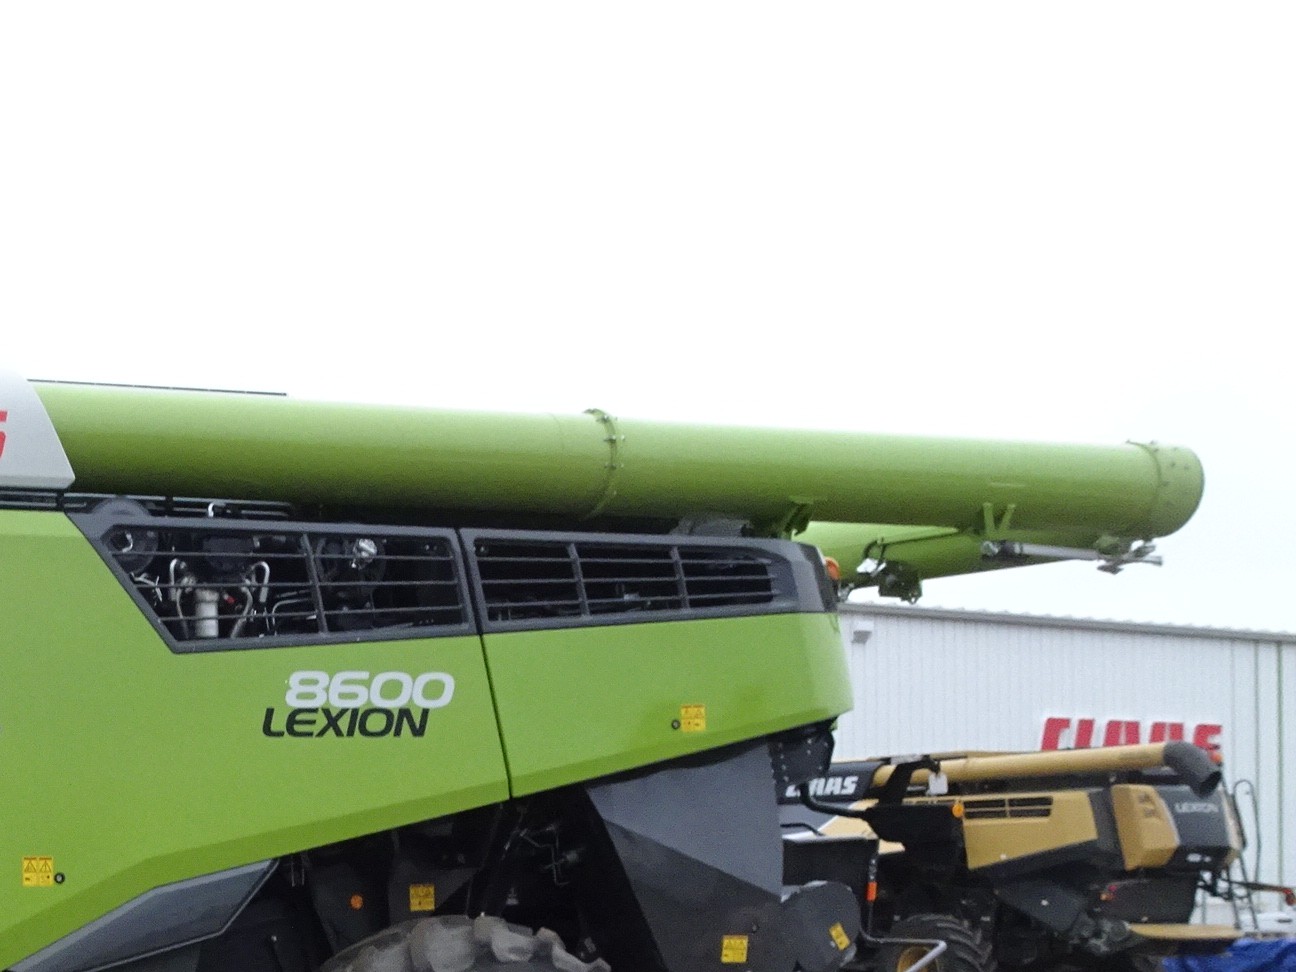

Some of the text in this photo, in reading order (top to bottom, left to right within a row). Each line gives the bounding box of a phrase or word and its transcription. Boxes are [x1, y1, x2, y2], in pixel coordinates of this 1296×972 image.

[285, 670, 455, 709] 8600
[262, 707, 430, 738] LEXION
[785, 775, 859, 798] CAAS
